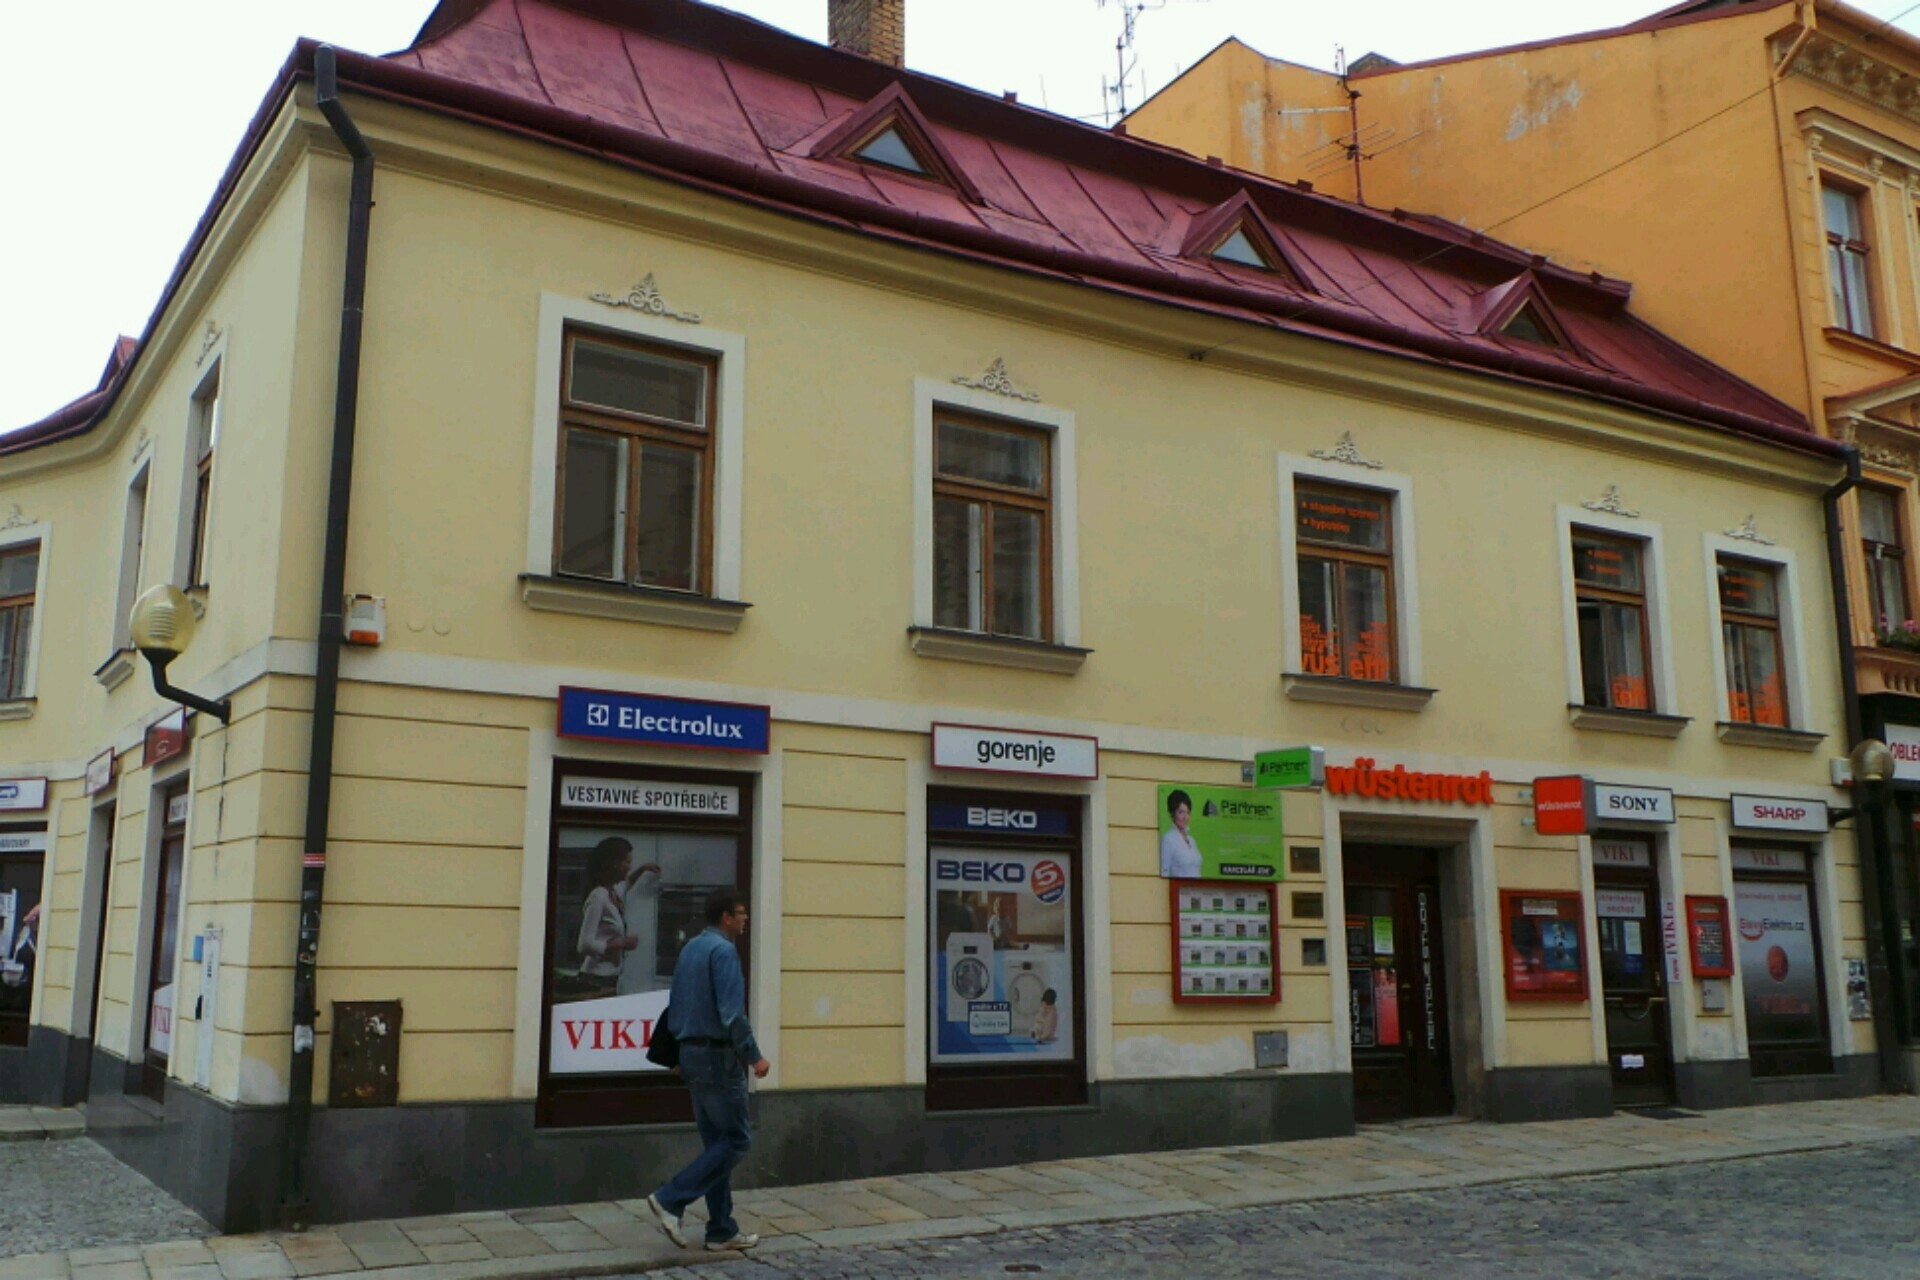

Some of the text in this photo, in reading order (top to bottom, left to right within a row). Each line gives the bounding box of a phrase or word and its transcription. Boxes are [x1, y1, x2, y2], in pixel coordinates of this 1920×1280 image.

[618, 706, 743, 740] Electrolux
[977, 740, 1056, 768] gorenje
[1890, 742, 1920, 761] OBLE
[1325, 757, 1494, 804] wüstenrot
[567, 785, 729, 811] VESTAVNÉ SPOTŘEBIČE
[1221, 800, 1273, 817] Partner
[1608, 795, 1659, 812] SONY
[967, 807, 1038, 829] BEKO
[1753, 804, 1807, 821] SHARP
[1601, 844, 1635, 862] VIKI
[937, 859, 1025, 884] BEKO
[561, 1018, 655, 1050] VIKI
